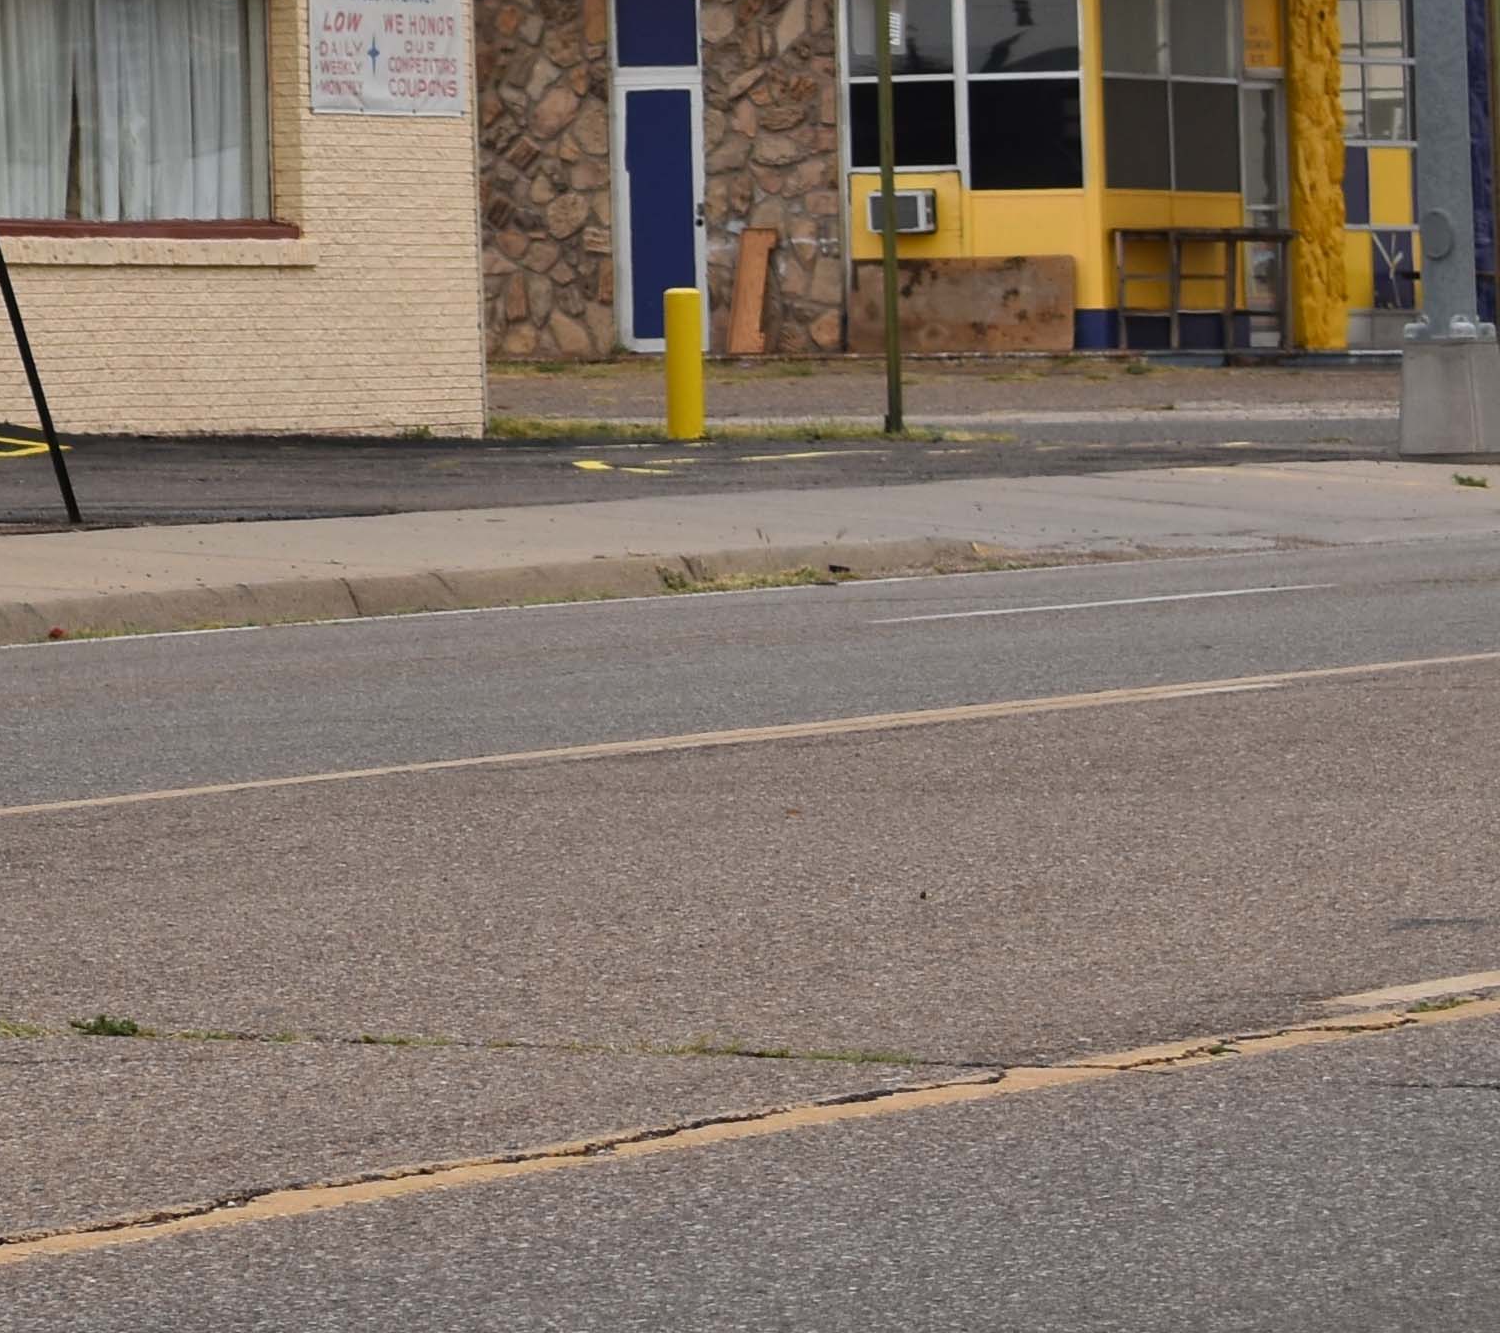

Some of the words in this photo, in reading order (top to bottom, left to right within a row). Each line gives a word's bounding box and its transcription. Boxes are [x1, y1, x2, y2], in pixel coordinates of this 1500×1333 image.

[323, 10, 363, 33] LOW
[382, 13, 404, 35] WE
[408, 14, 456, 37] HONOR
